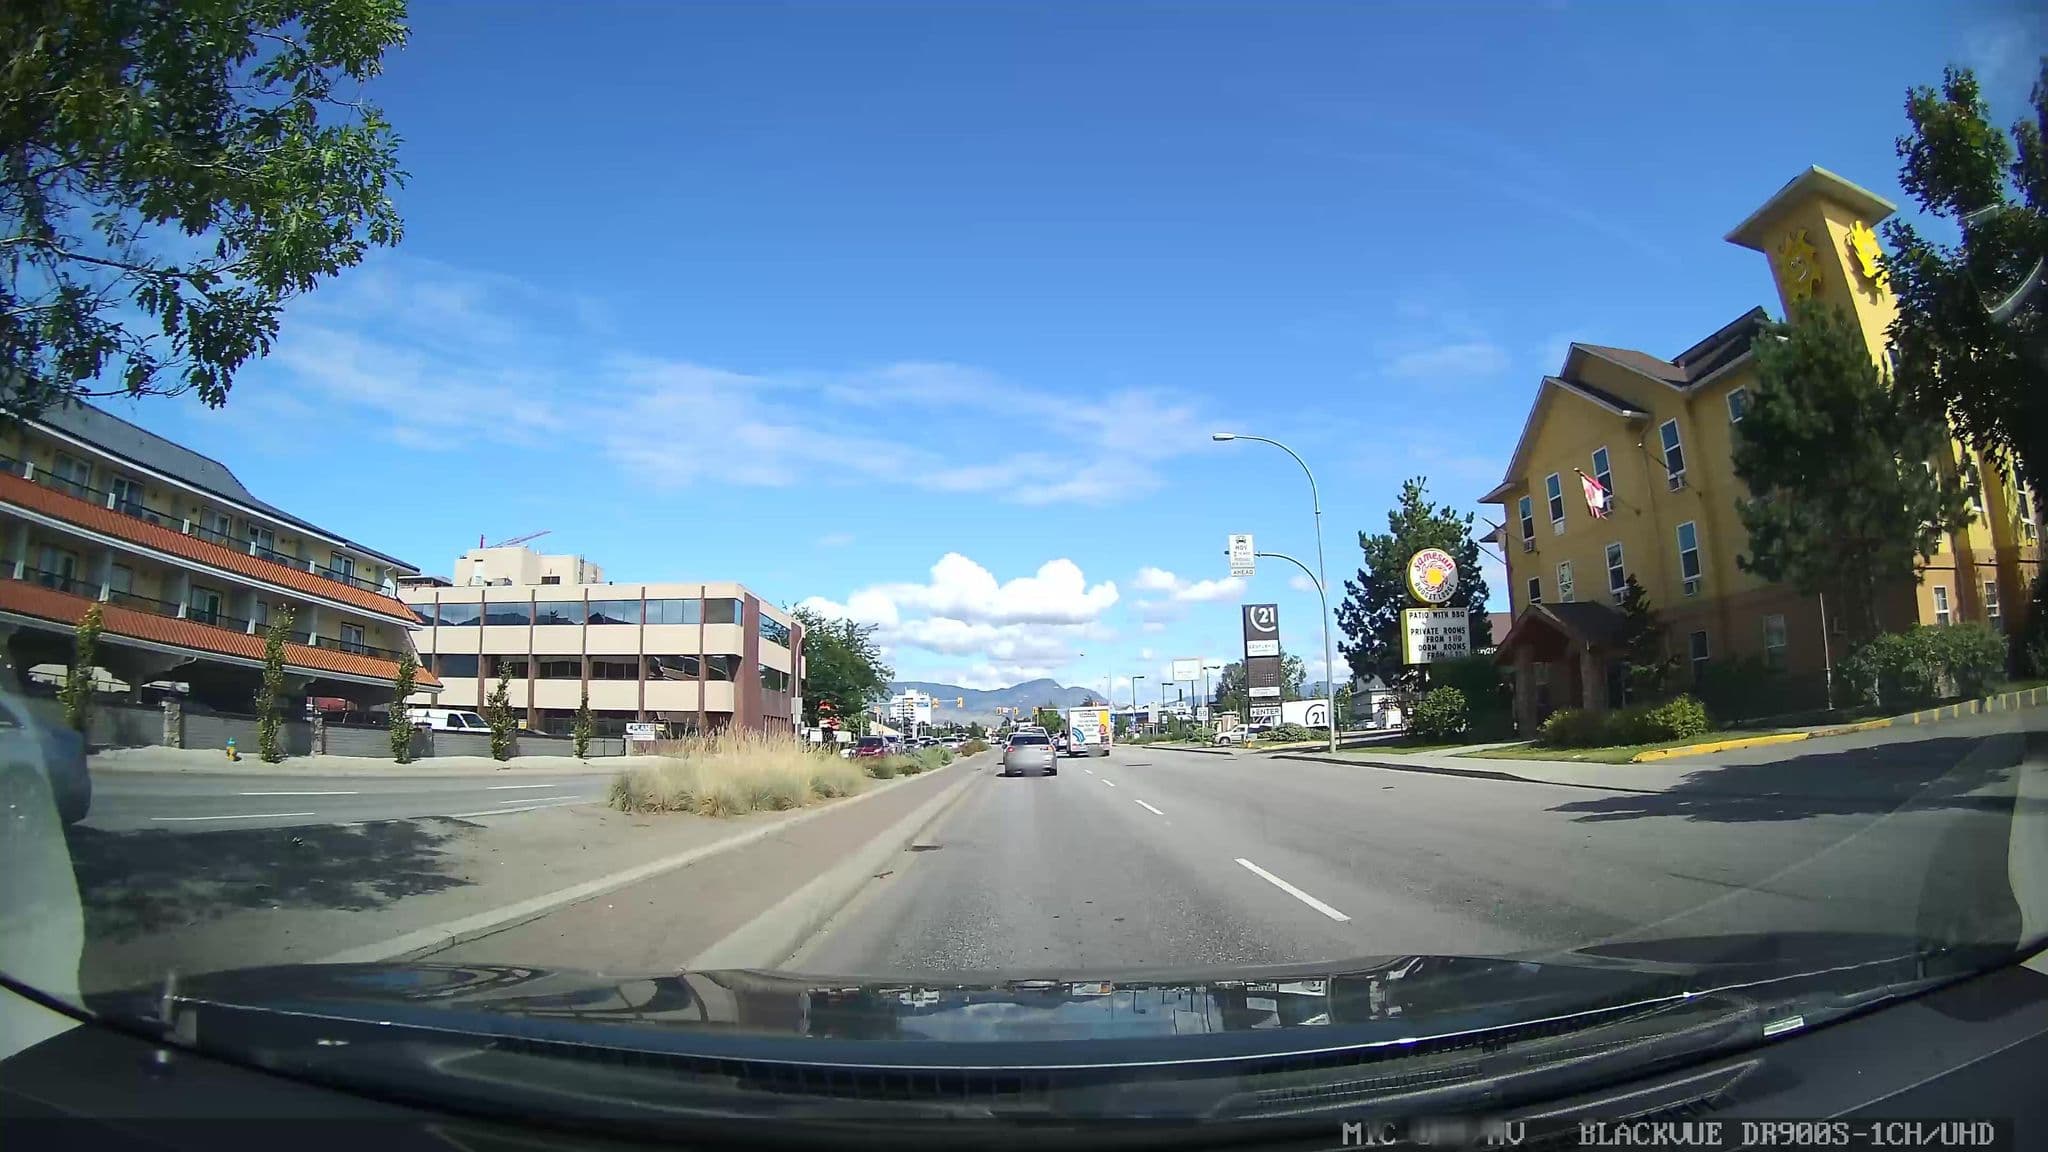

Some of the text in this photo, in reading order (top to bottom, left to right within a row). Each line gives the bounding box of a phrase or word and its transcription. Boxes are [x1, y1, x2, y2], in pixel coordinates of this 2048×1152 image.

[1433, 611, 1449, 619] WITH
[1411, 626, 1466, 635] PRIVATE ROOMS
[1426, 635, 1444, 643] FROM
[1427, 651, 1445, 660] FROM
[1256, 708, 1279, 716] ENTER
